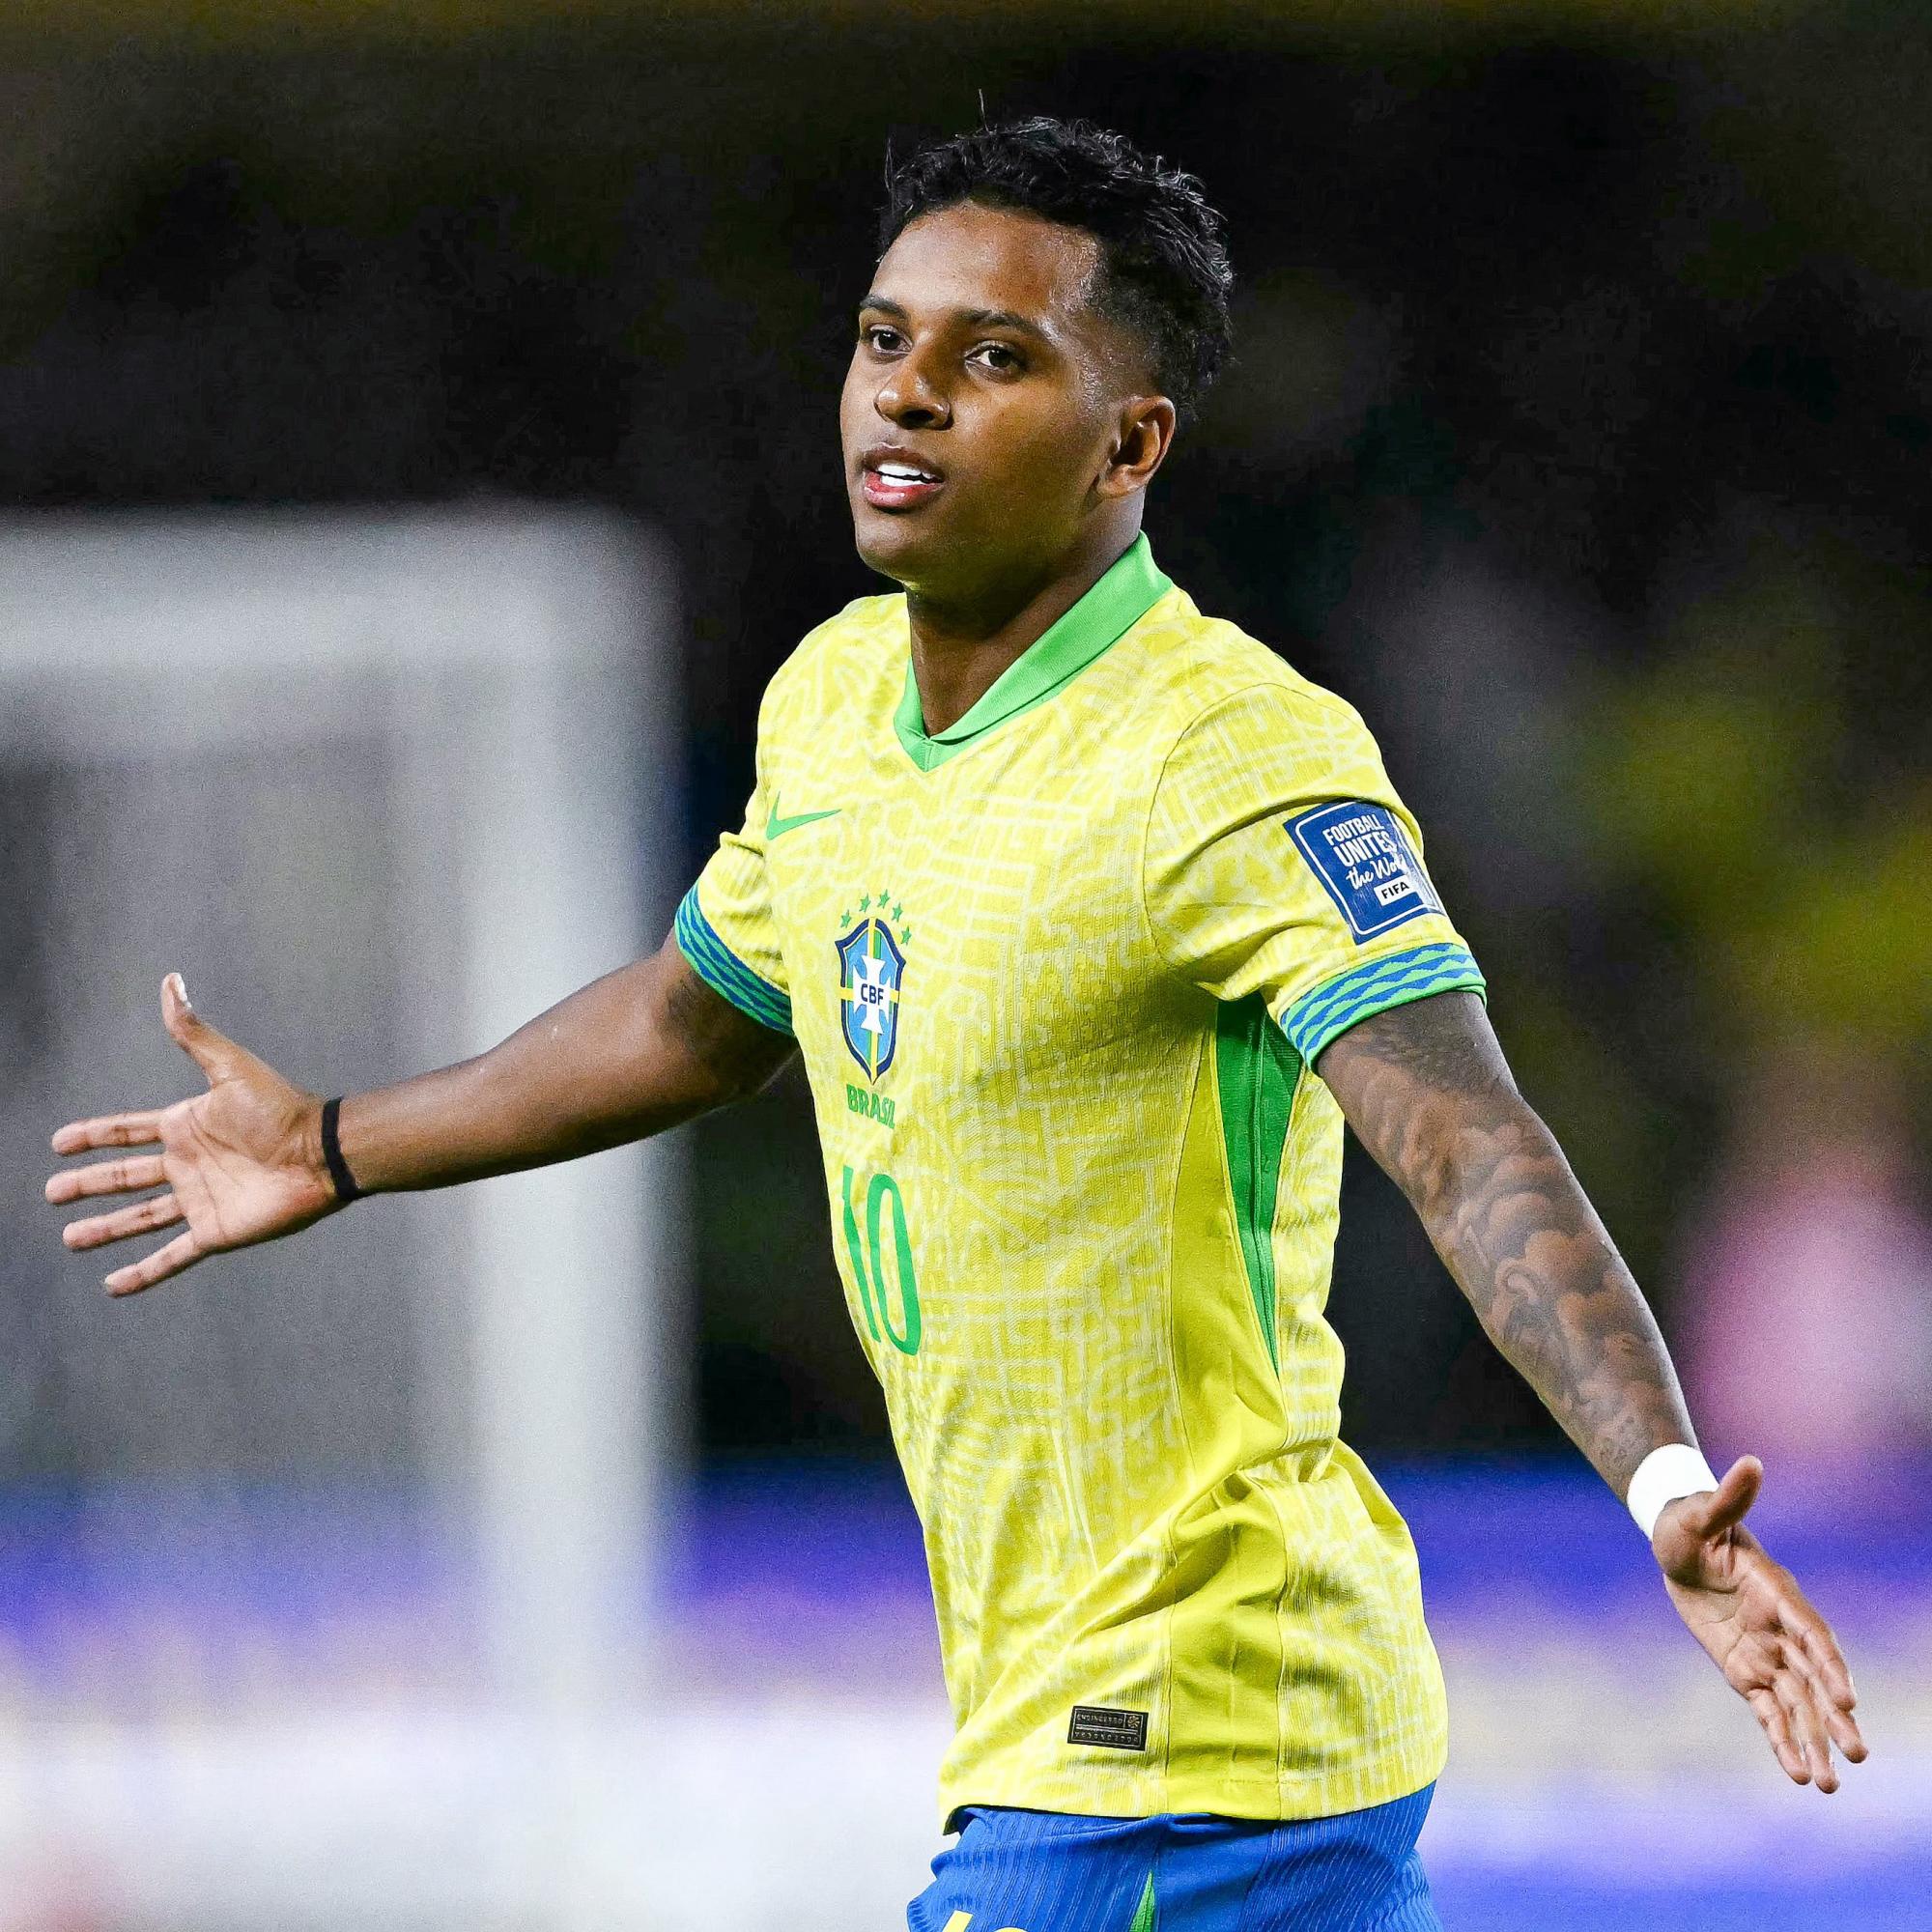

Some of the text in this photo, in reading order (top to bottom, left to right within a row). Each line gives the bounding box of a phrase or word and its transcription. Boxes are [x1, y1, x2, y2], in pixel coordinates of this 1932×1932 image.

[1322, 813, 1385, 845] FOOTBALL
[1333, 831, 1398, 867] UNITES
[1346, 866, 1375, 890] the
[1381, 881, 1410, 899] FIFA
[861, 983, 884, 1006] CBF
[846, 1083, 895, 1129] BRASIL
[841, 1165, 922, 1356] 10
